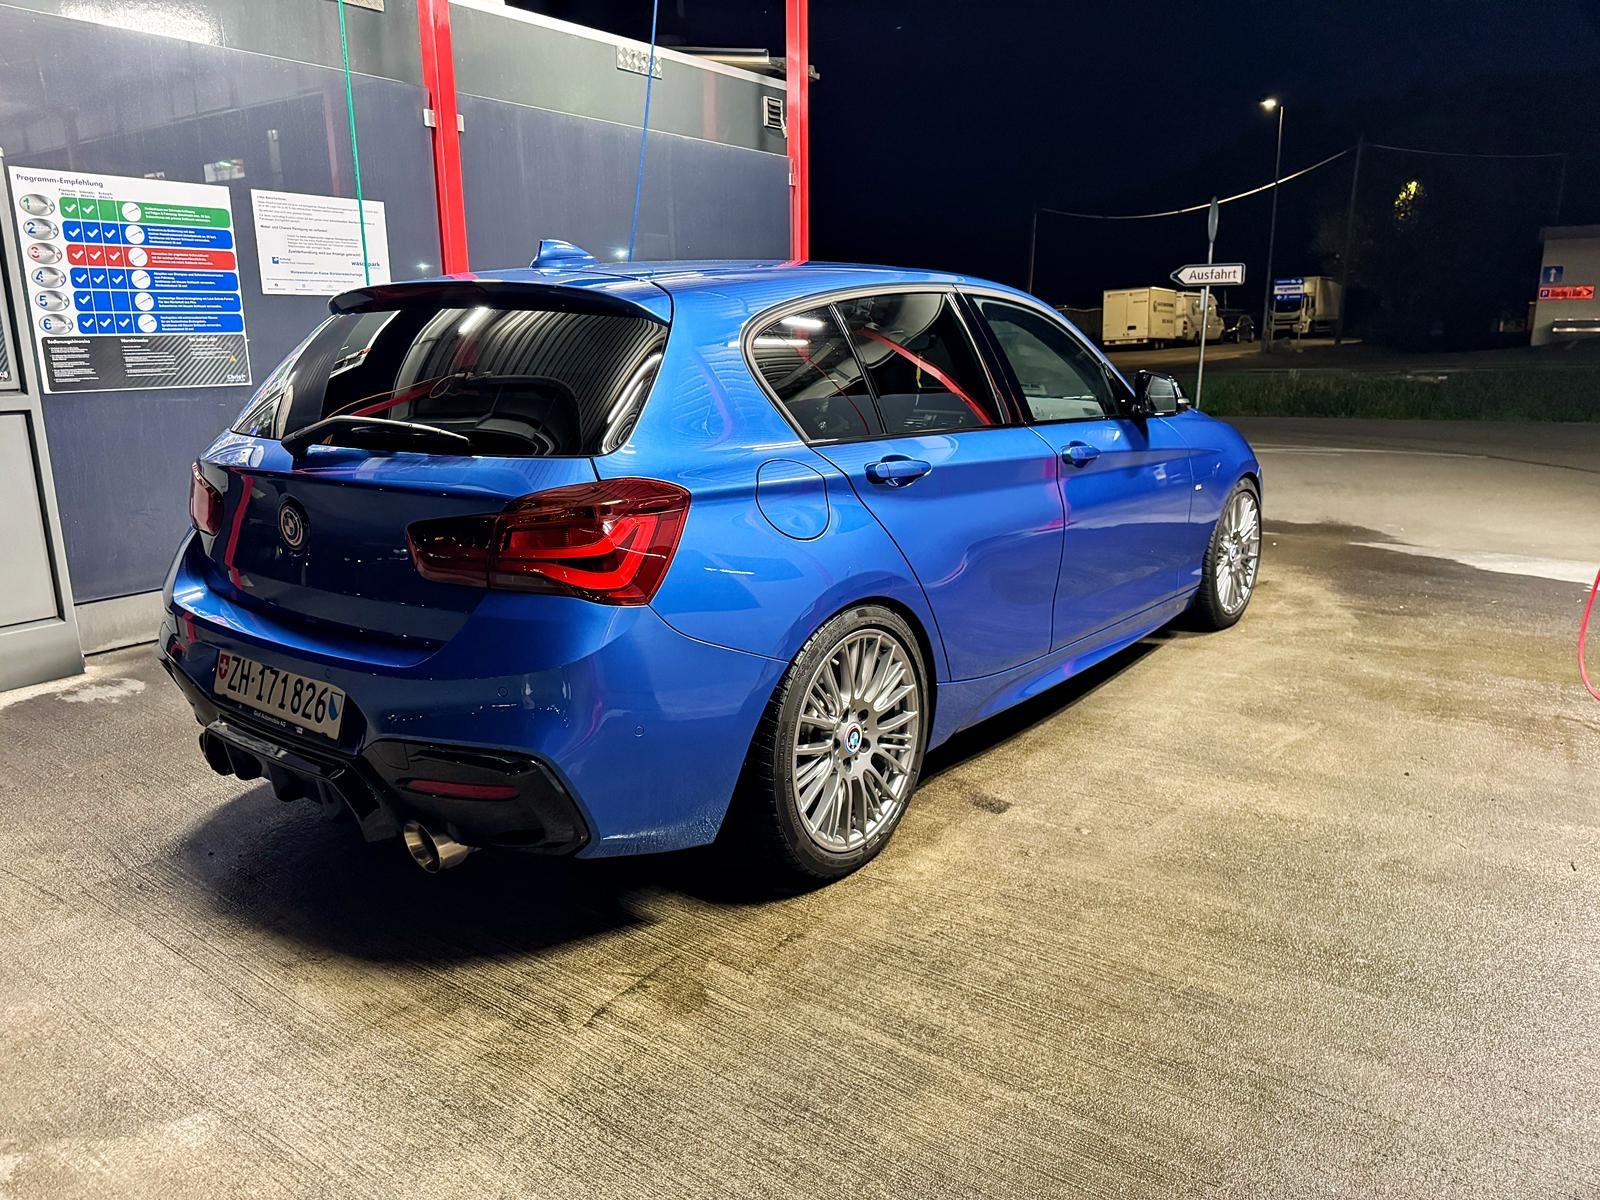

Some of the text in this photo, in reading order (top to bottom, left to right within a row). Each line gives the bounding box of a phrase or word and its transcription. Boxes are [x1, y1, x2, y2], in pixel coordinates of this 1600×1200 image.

[16, 174, 104, 188] Programm-Empfehlung
[23, 198, 30, 210] 1
[27, 222, 36, 234] 2
[31, 246, 40, 259] 3
[36, 270, 44, 282] 4
[1189, 268, 1236, 280] Ausfahrt
[39, 295, 48, 307] 5
[43, 318, 52, 330] 6
